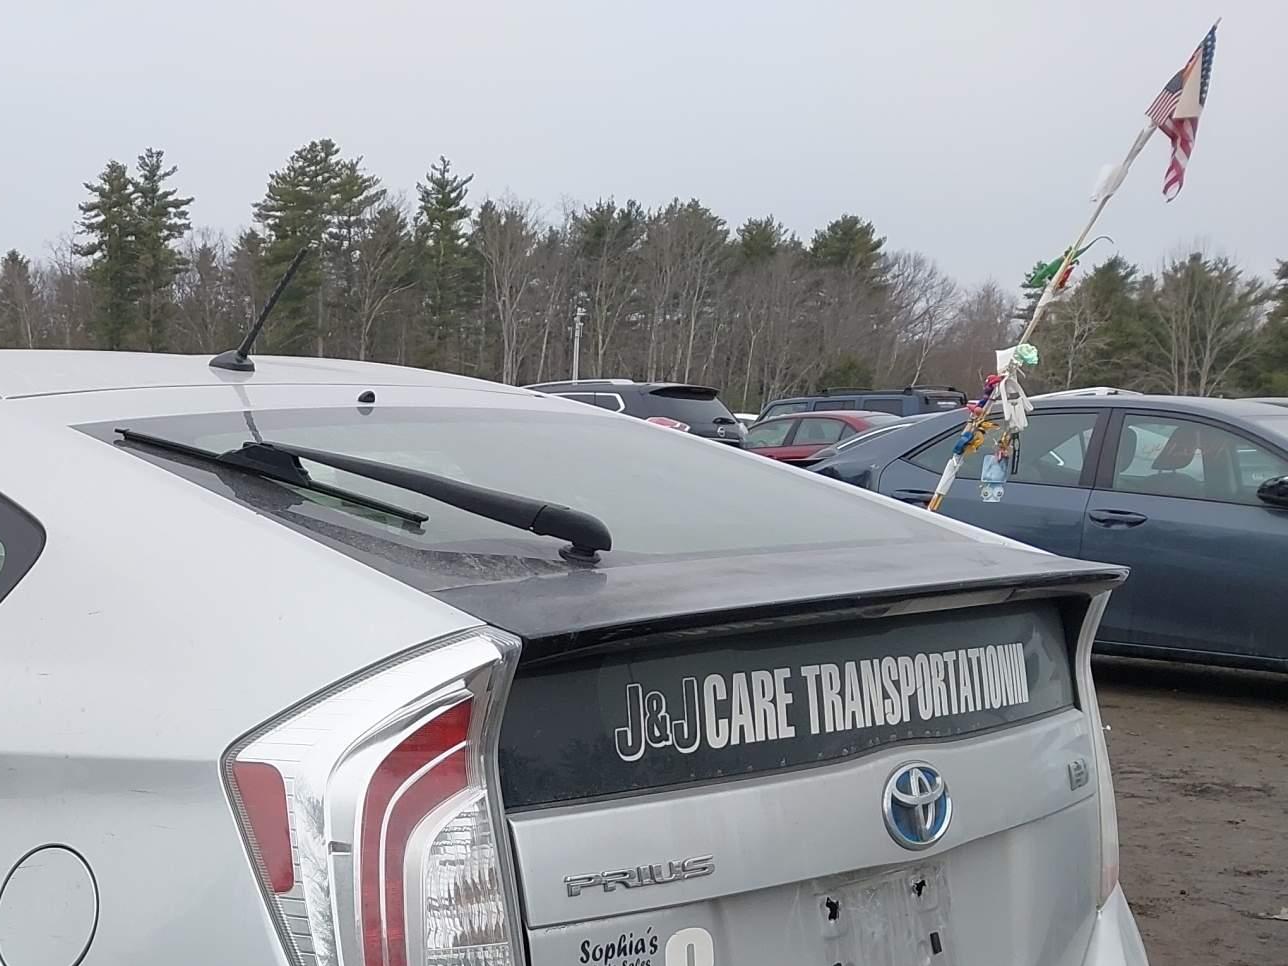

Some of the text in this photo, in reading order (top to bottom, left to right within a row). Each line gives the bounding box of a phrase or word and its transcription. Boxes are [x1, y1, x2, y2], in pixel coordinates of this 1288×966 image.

[614, 677, 702, 762] J&J
[703, 667, 796, 750] CARE
[563, 854, 716, 898] PRIUS
[579, 926, 658, 966] Sophia's
